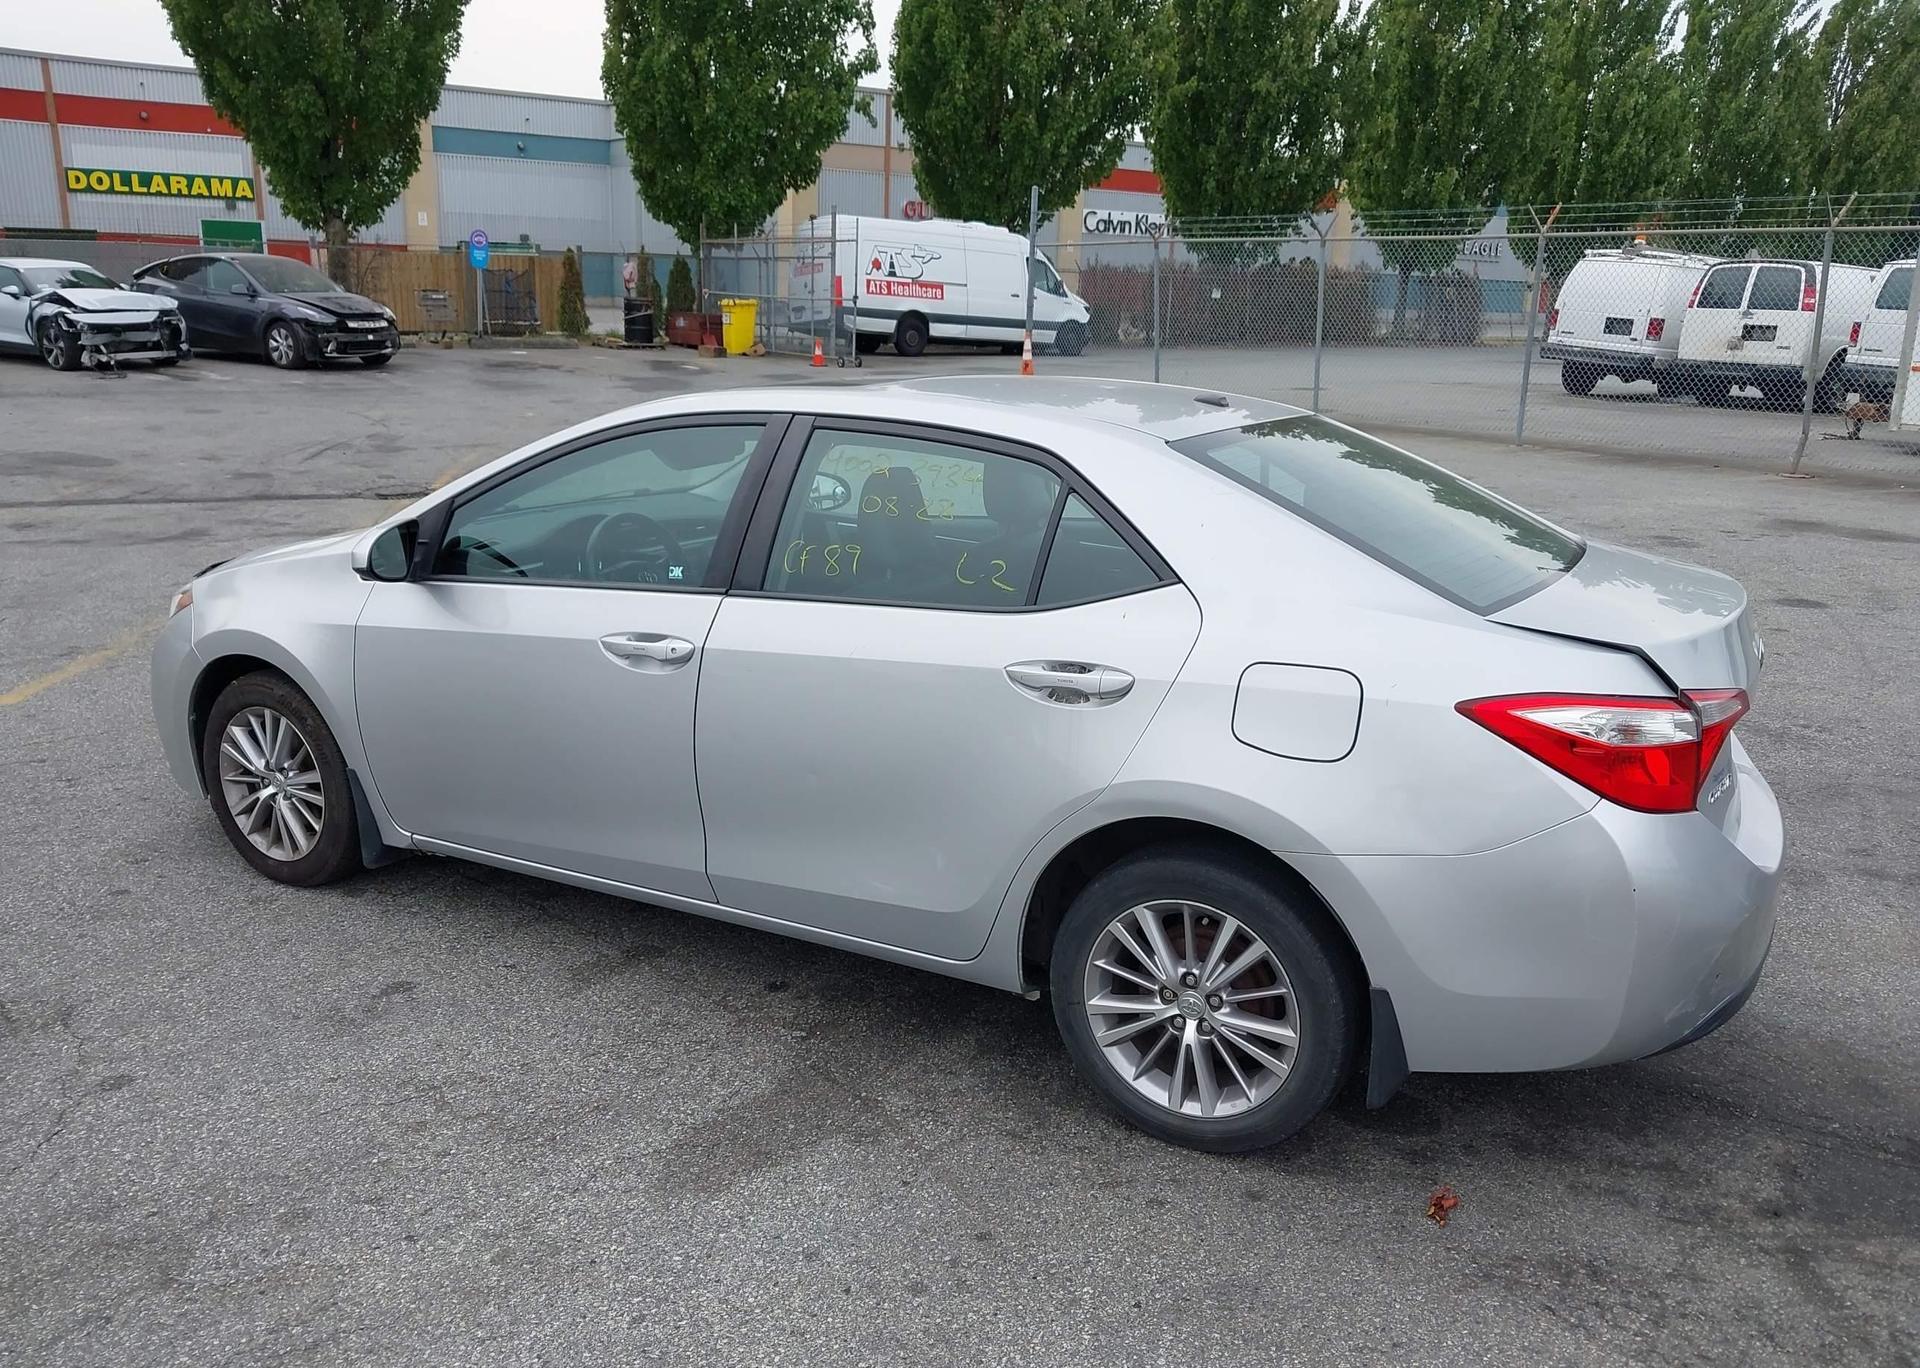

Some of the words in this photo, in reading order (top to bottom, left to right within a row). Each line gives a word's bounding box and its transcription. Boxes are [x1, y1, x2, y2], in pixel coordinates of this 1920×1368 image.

[67, 169, 254, 199] DOLLARAMA
[1084, 210, 1132, 235] Calvin
[1463, 240, 1503, 257] EAGLE
[865, 244, 930, 280] ATS
[869, 281, 888, 294] ATS
[890, 282, 943, 299] Healthcare
